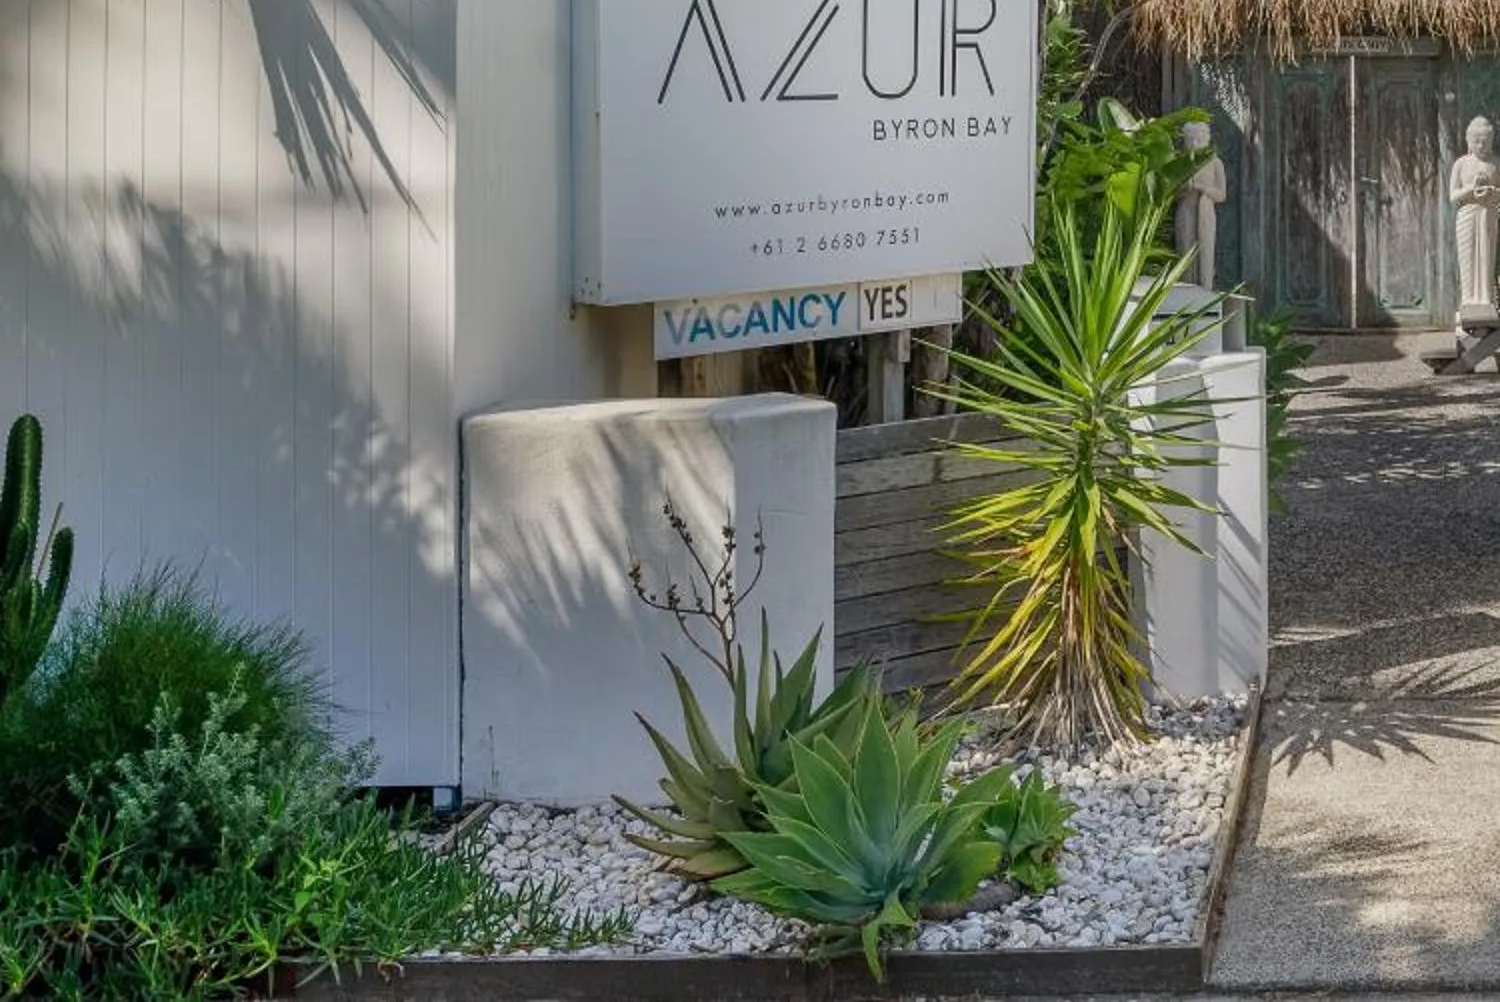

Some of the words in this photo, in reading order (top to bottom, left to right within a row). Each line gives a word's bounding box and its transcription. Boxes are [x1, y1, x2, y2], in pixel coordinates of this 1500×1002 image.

[872, 116, 956, 141] BYRON
[967, 115, 1014, 137] BAY
[714, 188, 950, 219] www.azurbyronbay.com
[750, 237, 784, 257] +61
[796, 234, 806, 253] 2
[817, 231, 867, 252] 6680
[875, 226, 921, 247] 7551
[663, 291, 848, 346] VACANCY
[864, 285, 908, 321] YES
